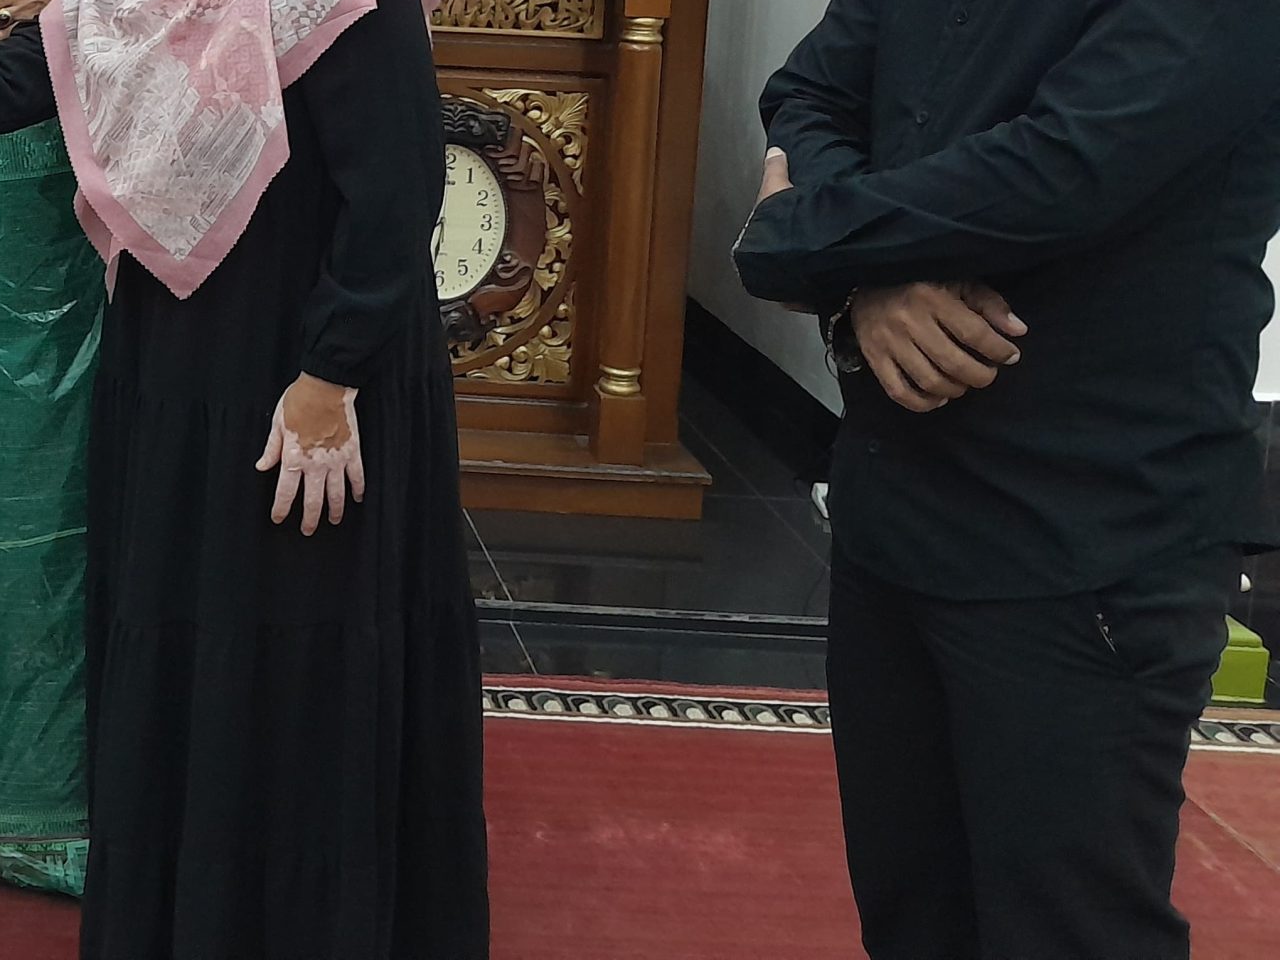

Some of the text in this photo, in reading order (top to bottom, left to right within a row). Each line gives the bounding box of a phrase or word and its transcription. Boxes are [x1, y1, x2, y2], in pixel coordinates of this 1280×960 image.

[465, 167, 474, 184] 1
[476, 189, 489, 207] 2
[480, 213, 493, 232] 3
[471, 237, 484, 255] 4
[457, 258, 469, 276] 5
[435, 270, 445, 287] 6
